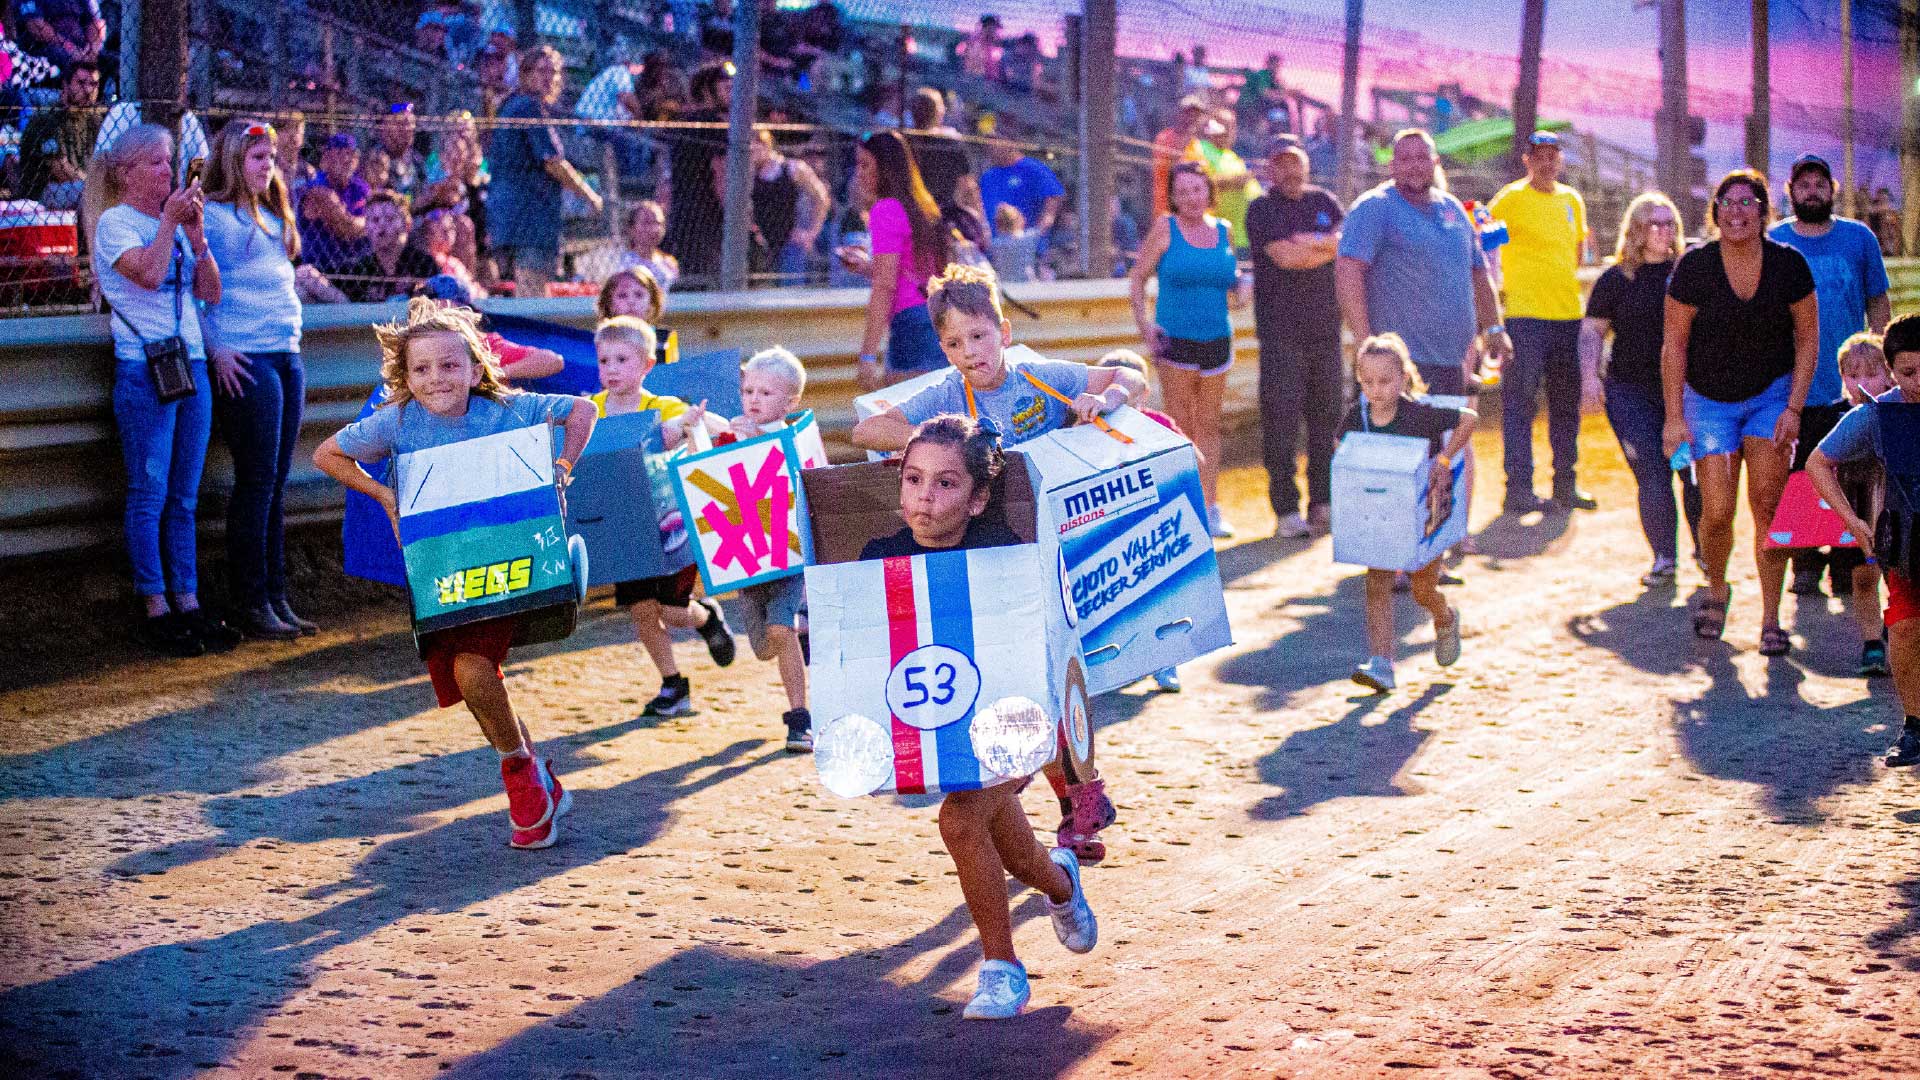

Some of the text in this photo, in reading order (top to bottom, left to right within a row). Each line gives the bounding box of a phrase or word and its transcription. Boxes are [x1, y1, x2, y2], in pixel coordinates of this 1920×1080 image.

[1063, 467, 1155, 518] MAHLE
[1059, 508, 1106, 535] pistons
[1121, 508, 1183, 567] VALLEY
[1130, 533, 1193, 589] SERVICE
[903, 663, 956, 709] 53
